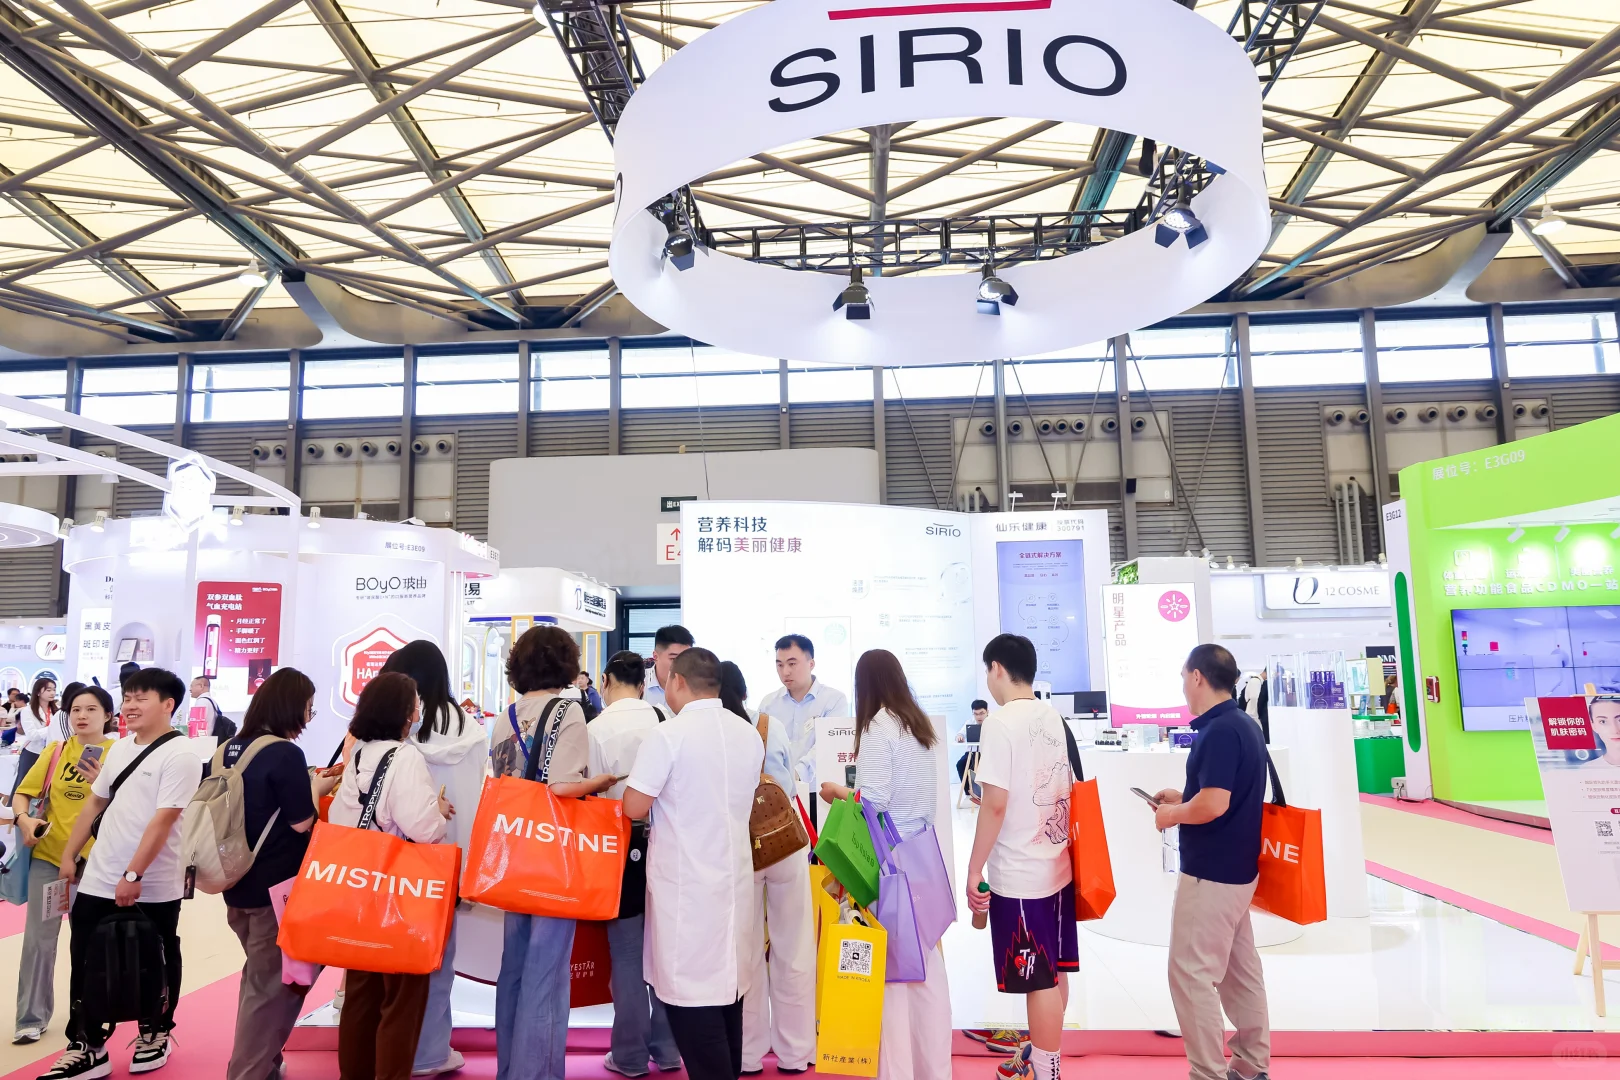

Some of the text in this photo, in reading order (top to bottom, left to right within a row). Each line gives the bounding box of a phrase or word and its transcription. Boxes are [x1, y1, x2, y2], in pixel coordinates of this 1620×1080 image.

[769, 26, 1127, 113] SIRIO
[697, 516, 768, 533] 营养科技
[925, 526, 961, 538] SIRIO
[995, 521, 1047, 532] 仙乐健康
[665, 544, 681, 561] E
[697, 537, 802, 553] 解码美丽健康
[402, 575, 427, 591] 玻由
[465, 582, 480, 596] 易
[1325, 586, 1380, 596] 12 COSME
[206, 602, 243, 611] 气血充电站
[1112, 592, 1127, 646] 明星产品
[1548, 717, 1585, 727] 解锁你的
[1550, 728, 1587, 737] 肌肤密码
[305, 860, 446, 899] MISTINE
